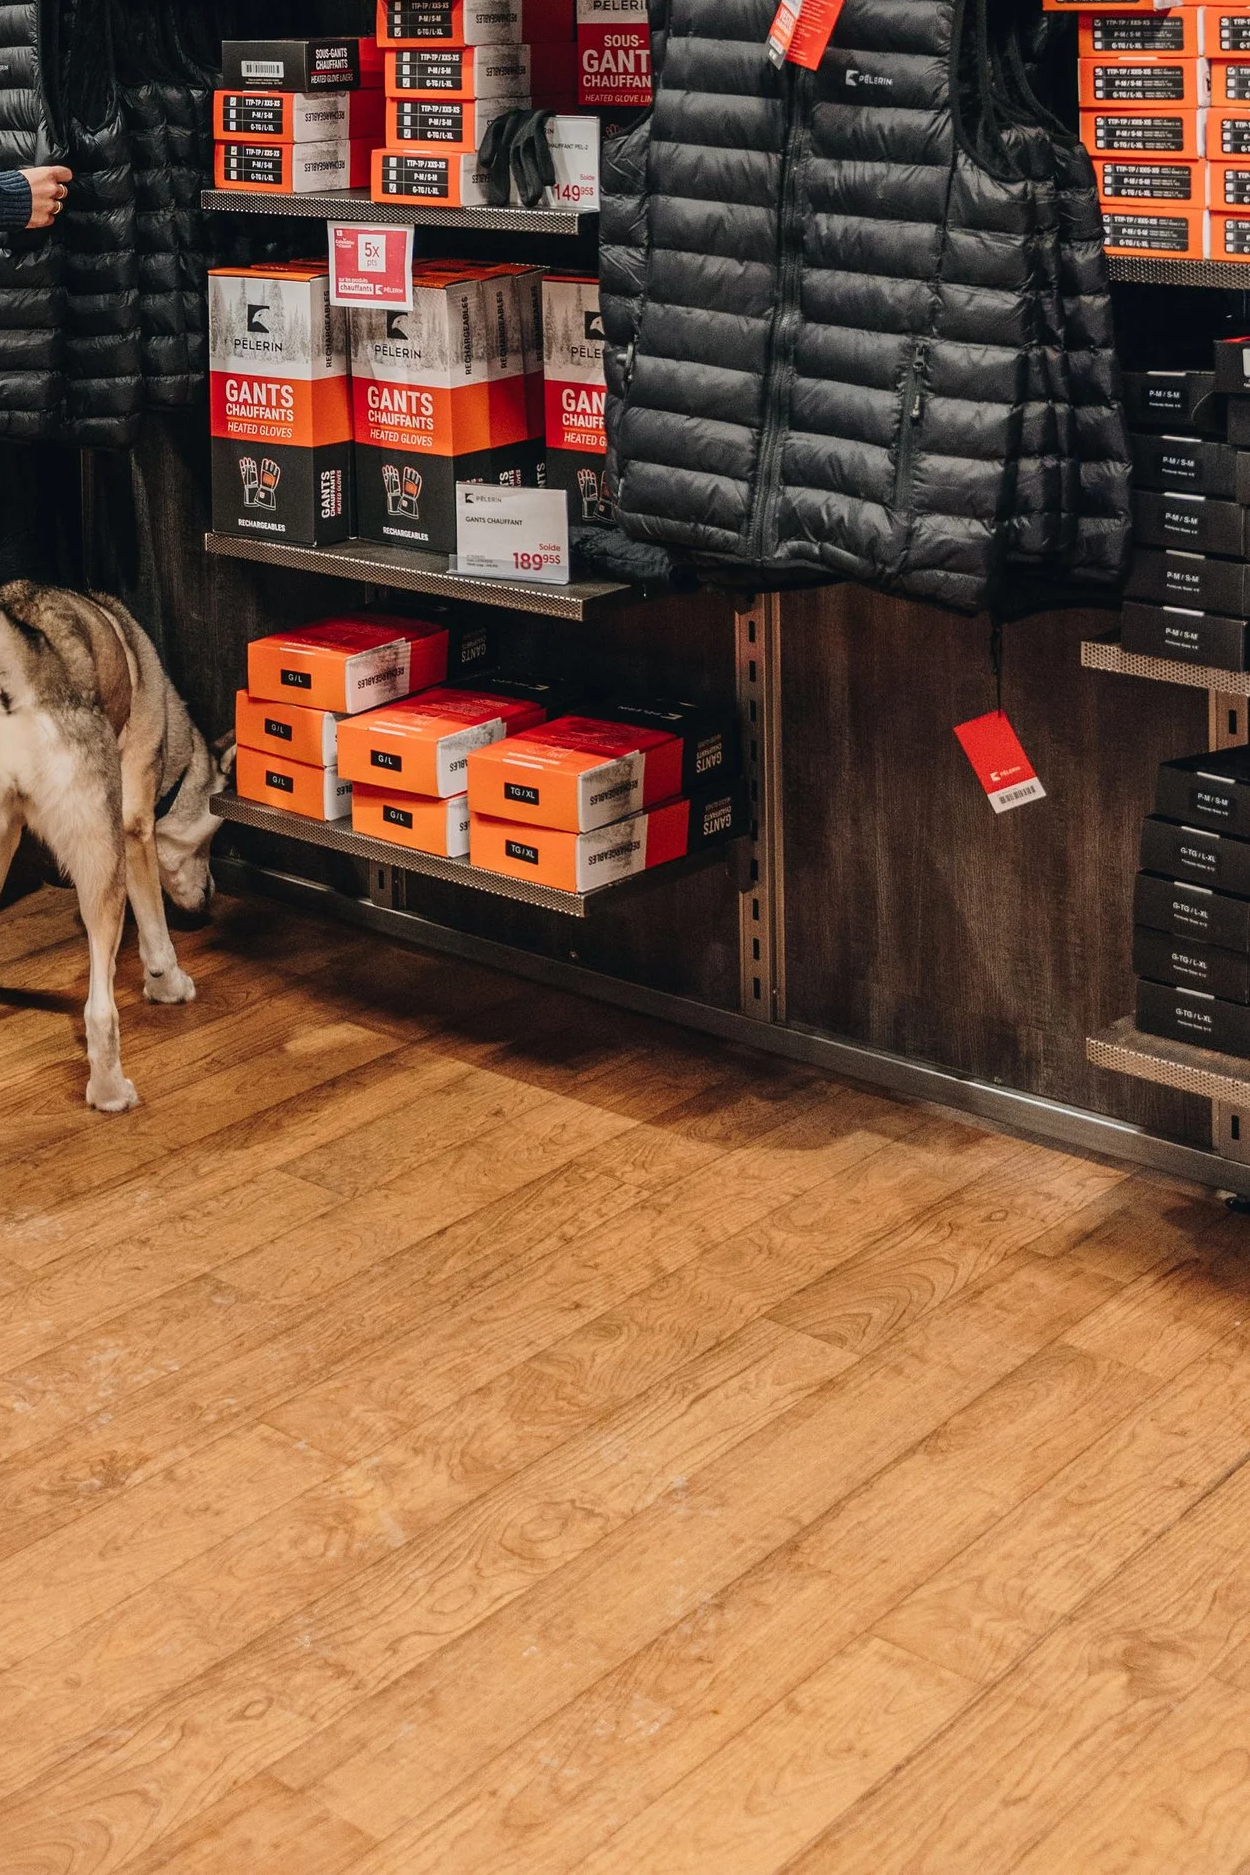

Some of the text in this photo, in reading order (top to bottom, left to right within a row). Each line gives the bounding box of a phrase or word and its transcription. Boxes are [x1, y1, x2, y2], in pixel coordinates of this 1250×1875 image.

[604, 34, 645, 47] SOUS-
[315, 48, 348, 59] SOUS-GANTS
[582, 49, 650, 73] GANT
[315, 59, 348, 70] CHAUFFANTS
[311, 75, 327, 84] HEATED
[327, 74, 339, 83] GLOVE
[583, 74, 651, 88] CHAUFFAN
[585, 93, 653, 103] HEATED GLOVE LIN
[305, 111, 345, 122] RECHARGEABLES
[304, 159, 345, 173] RECHARGEABLES
[364, 241, 380, 258] 5x
[366, 259, 378, 268] pts
[340, 283, 373, 293] chauffants
[323, 290, 332, 368] RECHARGEABLES
[463, 295, 472, 376] RECHARGEABLES
[497, 290, 507, 369] RECHARGEABLES
[225, 379, 294, 408] GANTS
[367, 385, 434, 416] GANTS
[562, 388, 606, 415] GAN
[225, 403, 294, 422] CHAUFFANTS
[368, 409, 434, 430] CHAUFFANTS
[562, 413, 605, 429] CHAUFF
[227, 422, 293, 438] HEATED GLOVES
[370, 428, 433, 447] HEATED GLOVES
[564, 432, 597, 446] HEATED
[321, 471, 331, 519] GANTS
[238, 518, 286, 532] RECHARGEABLES
[465, 516, 523, 526] GANTS CHAUFFANT
[382, 526, 429, 541] RECHARGEABLES
[538, 543, 561, 552] Solde
[357, 666, 405, 689] RECHARGEABLES
[703, 814, 732, 836] GANTS
[588, 840, 640, 866] RECHARGEABLES
